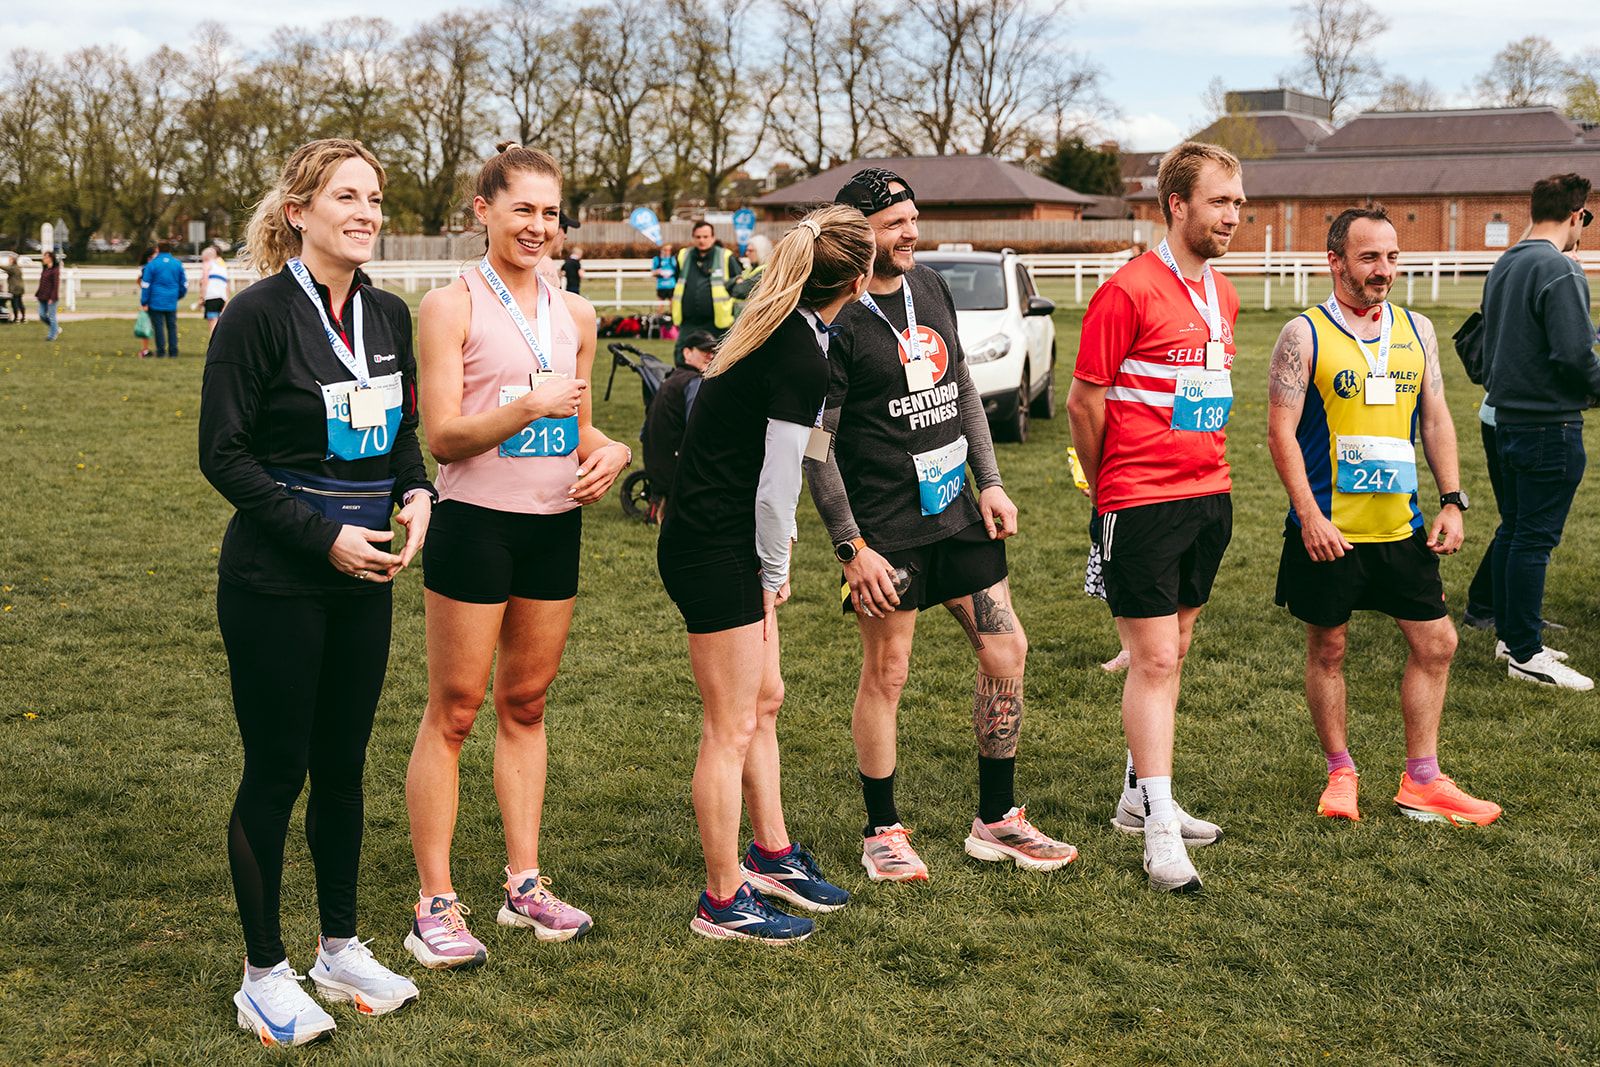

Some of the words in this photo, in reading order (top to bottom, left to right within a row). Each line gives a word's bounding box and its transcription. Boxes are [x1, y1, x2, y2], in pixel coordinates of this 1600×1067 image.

[484, 267, 503, 291] TEWV
[499, 288, 512, 306] 10k
[509, 304, 525, 327] 2025
[523, 326, 541, 352] TEWV
[1165, 348, 1204, 362] SELB
[1182, 386, 1204, 398] 10k
[1183, 379, 1203, 387] TEWV
[331, 393, 349, 404] TEW
[332, 403, 350, 418] 10
[908, 401, 958, 431] FITNESS
[1193, 406, 1224, 429] 138
[357, 425, 388, 454] 70
[520, 426, 565, 453] 213
[1341, 450, 1363, 461] 10k
[921, 465, 943, 481] 10k
[1353, 468, 1399, 490] 247
[937, 475, 960, 509] 209
